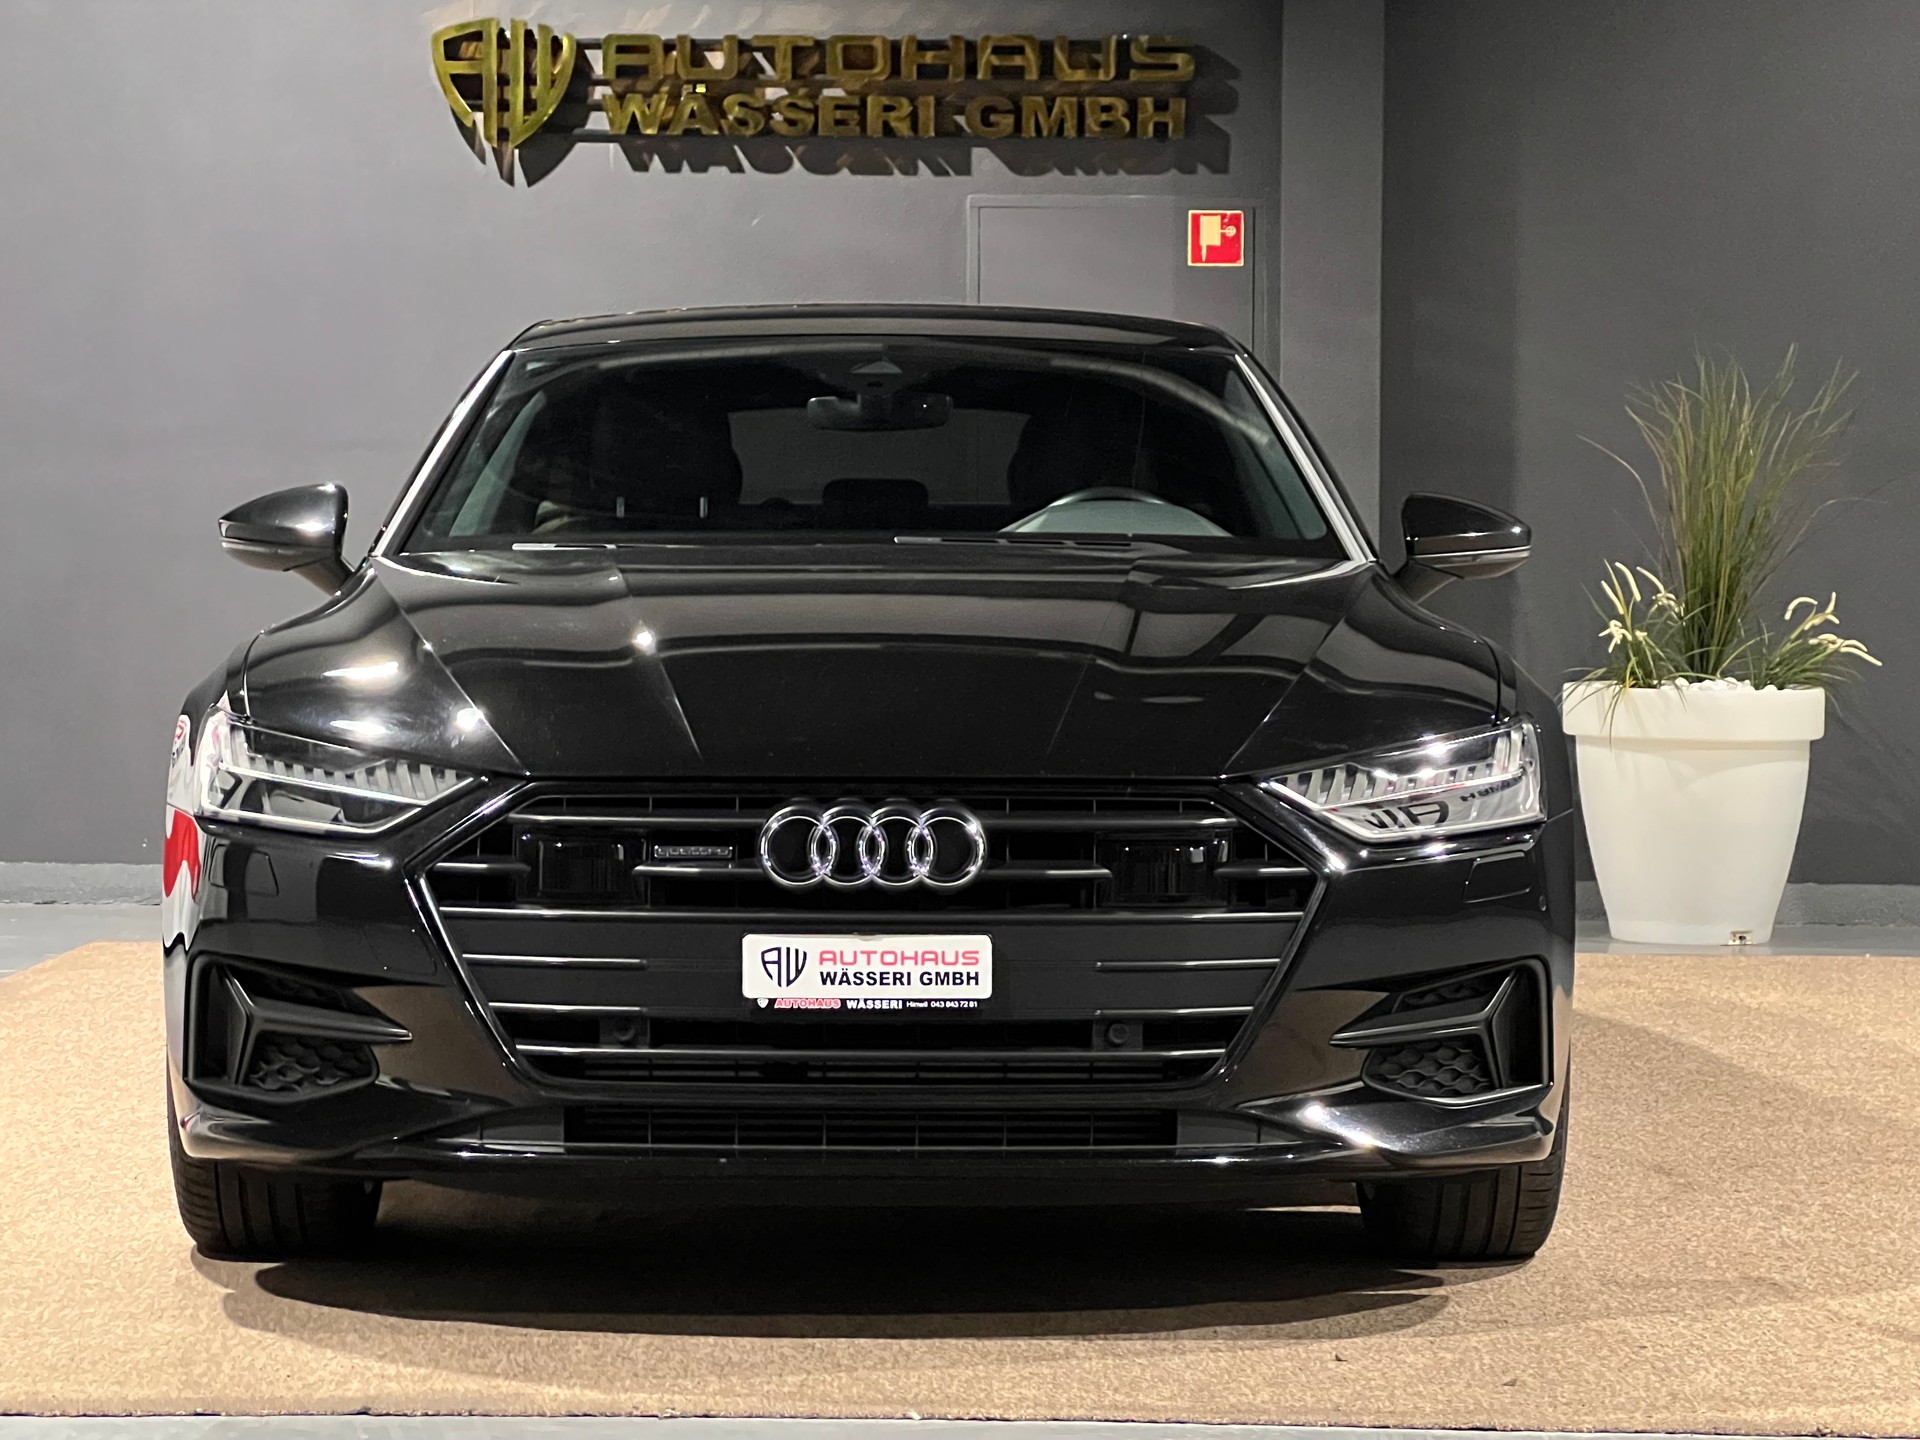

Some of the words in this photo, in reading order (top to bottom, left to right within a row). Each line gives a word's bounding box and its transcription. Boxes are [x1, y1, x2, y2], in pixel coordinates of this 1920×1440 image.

[602, 34, 1195, 81] AUTOHAUS
[604, 83, 936, 137] WÄSSERI
[964, 97, 1187, 138] GMBH
[819, 950, 980, 966] AUTOHAUS
[820, 968, 911, 986] WÄSSERI
[919, 971, 979, 986] GMBH
[774, 998, 841, 1009] AUTOHAUS
